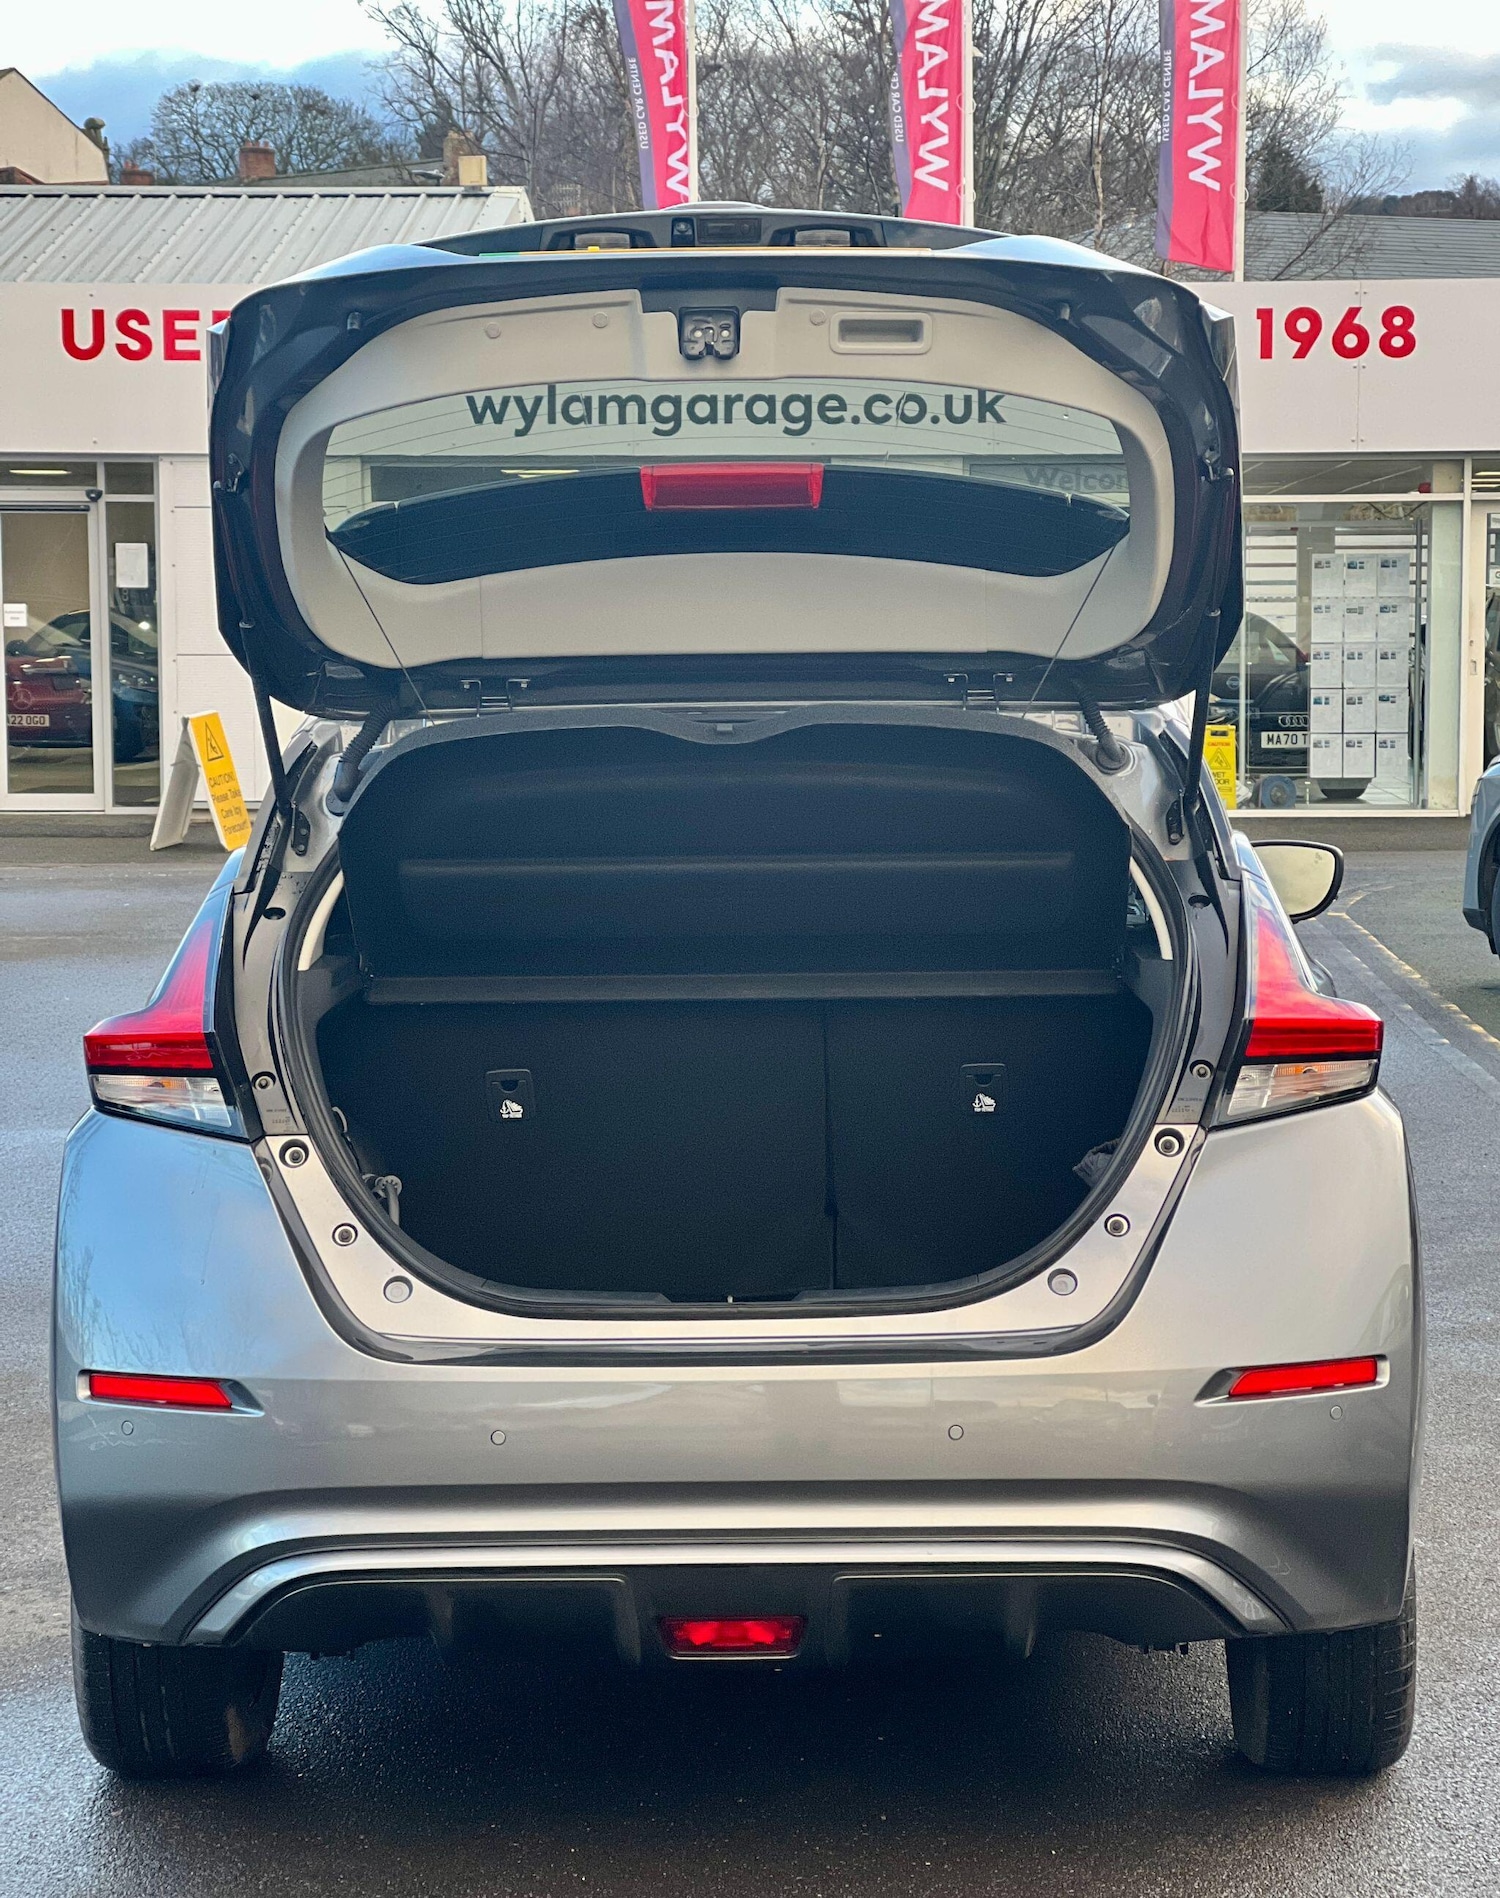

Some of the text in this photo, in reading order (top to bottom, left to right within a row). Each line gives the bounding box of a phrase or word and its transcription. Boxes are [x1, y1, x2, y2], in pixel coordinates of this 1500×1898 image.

[61, 308, 231, 361] USE
[1256, 305, 1416, 359] 1968
[465, 384, 1007, 437] wylamgarage.co.uk
[7, 715, 46, 725] 22 OGO
[1267, 734, 1298, 745] MA70
